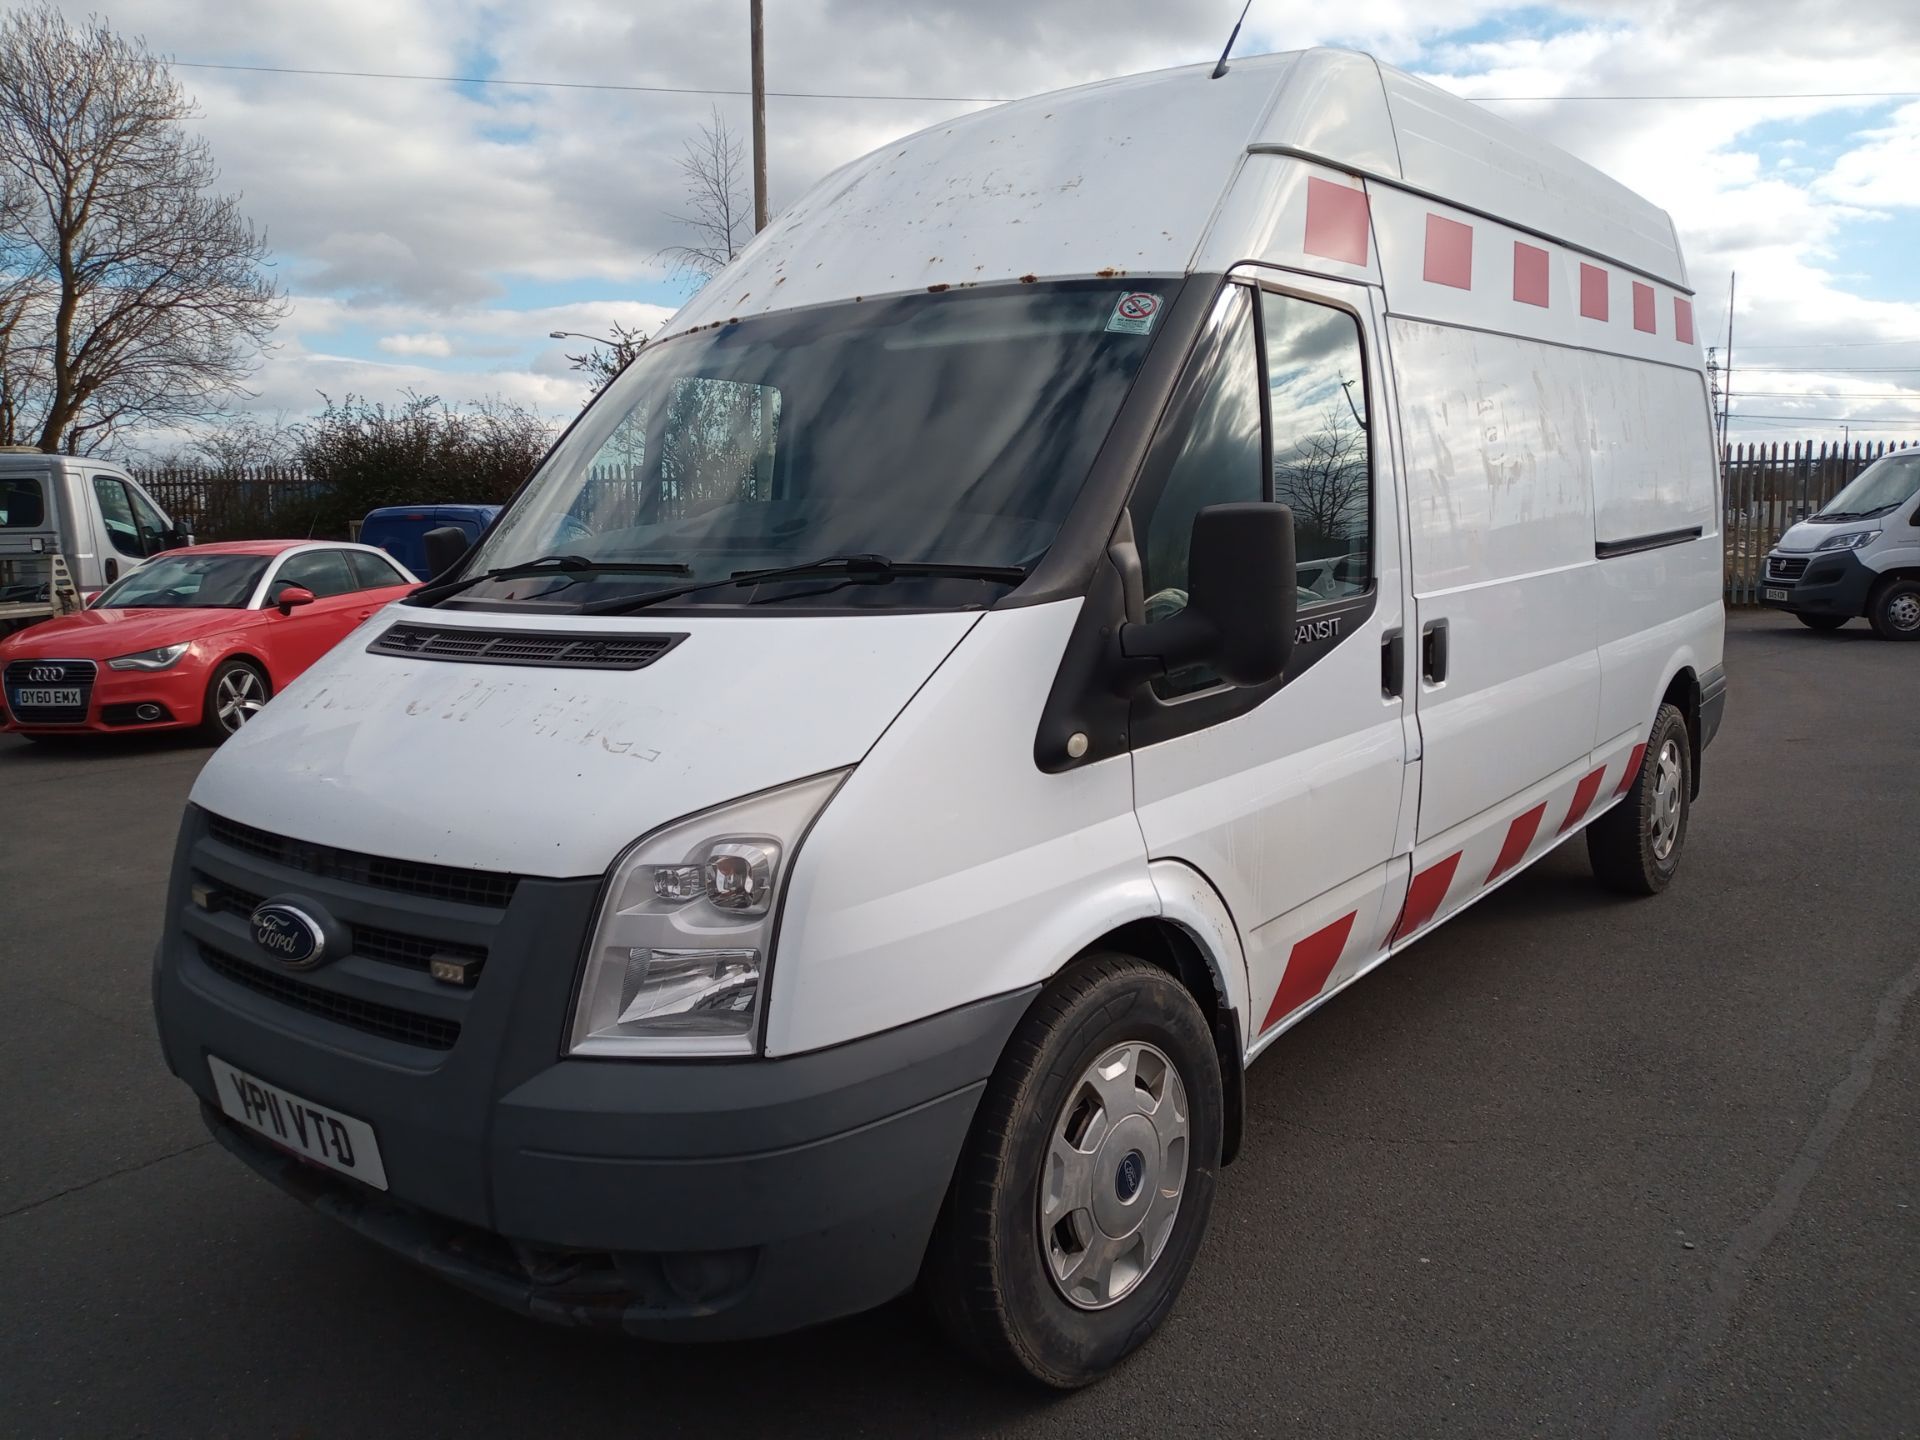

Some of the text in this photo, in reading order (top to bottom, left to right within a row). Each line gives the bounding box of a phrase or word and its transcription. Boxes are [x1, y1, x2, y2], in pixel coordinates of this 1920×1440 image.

[53, 690, 79, 704] EMX
[257, 914, 299, 953] Ford
[230, 1072, 356, 1169] YP11 VTD
